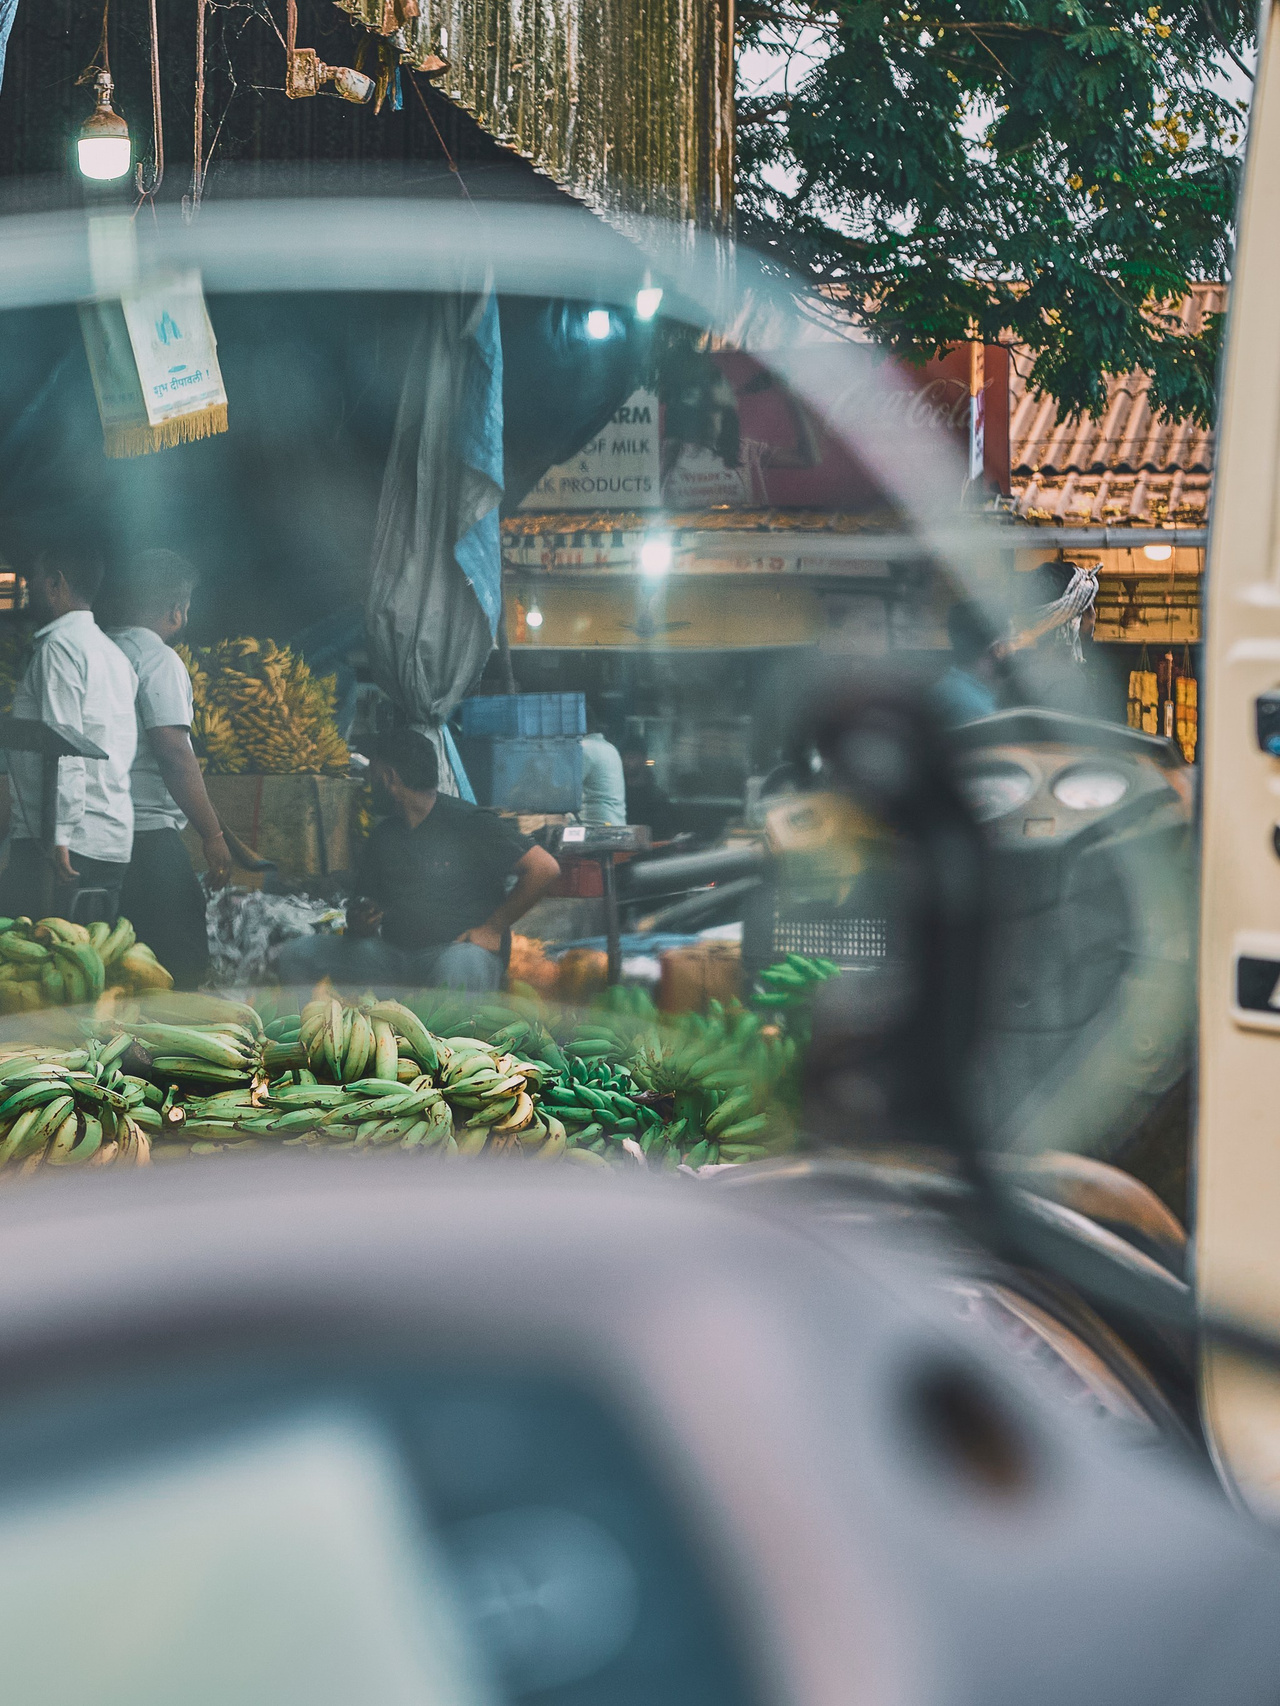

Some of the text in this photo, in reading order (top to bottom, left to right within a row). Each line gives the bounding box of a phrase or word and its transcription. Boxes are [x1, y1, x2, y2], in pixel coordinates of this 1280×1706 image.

[153, 383, 168, 398] शुभ
[170, 370, 203, 391] दीपावली
[612, 438, 650, 455] MILK
[579, 461, 589, 473] &
[561, 476, 652, 493] PRODUCTS
